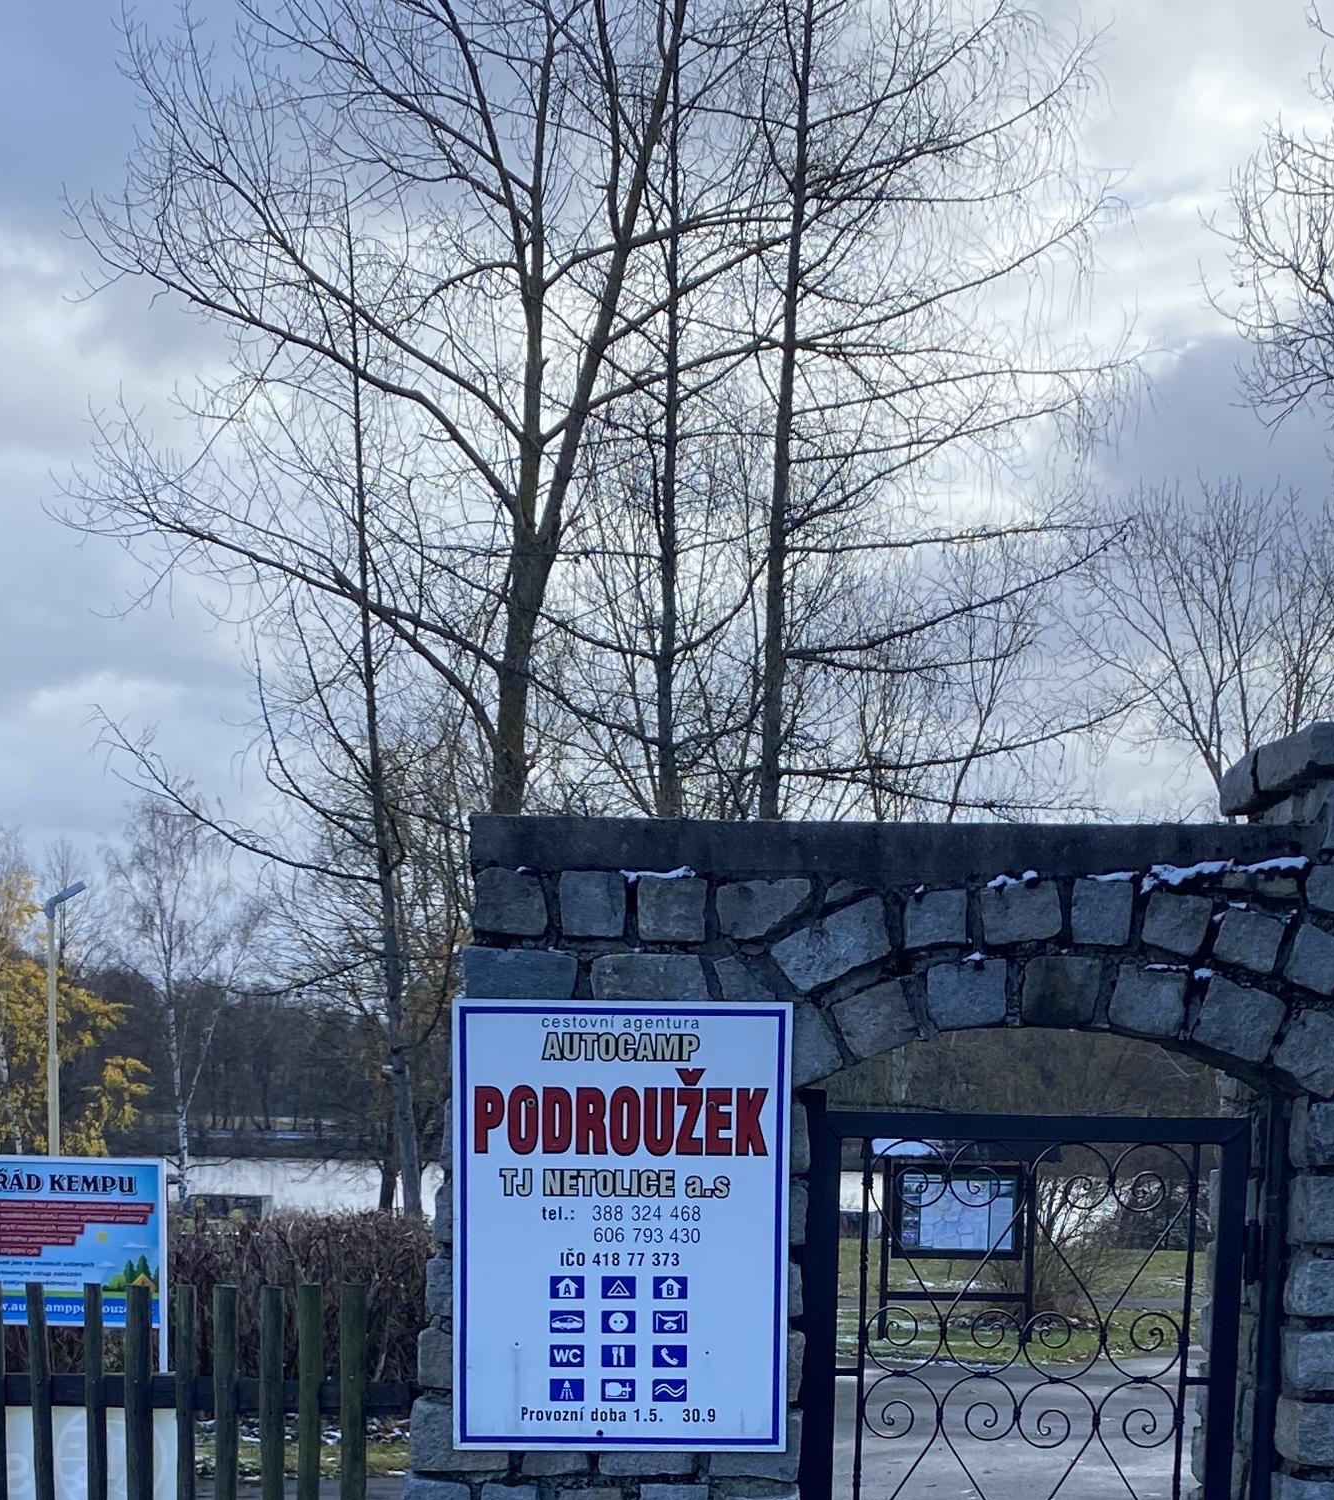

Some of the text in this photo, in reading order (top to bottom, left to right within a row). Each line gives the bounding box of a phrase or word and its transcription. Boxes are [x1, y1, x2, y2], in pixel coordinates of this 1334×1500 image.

[541, 1014, 700, 1032] cestovní agentura
[541, 1032, 700, 1062] AUTOCAMP
[474, 1068, 769, 1157] PODROUŽEK
[49, 1174, 137, 1195] KEMPU
[499, 1168, 533, 1197] TJ
[543, 1169, 676, 1198] NETOLICE
[542, 1205, 701, 1222] tel.: 388 324 468
[593, 1227, 701, 1244] 606 793 430
[592, 1252, 620, 1267] 418
[627, 1252, 645, 1267] 77
[651, 1252, 680, 1267] 373
[553, 1349, 582, 1364] WC
[520, 1406, 717, 1423] Provozní doba 1.5. 30.9
